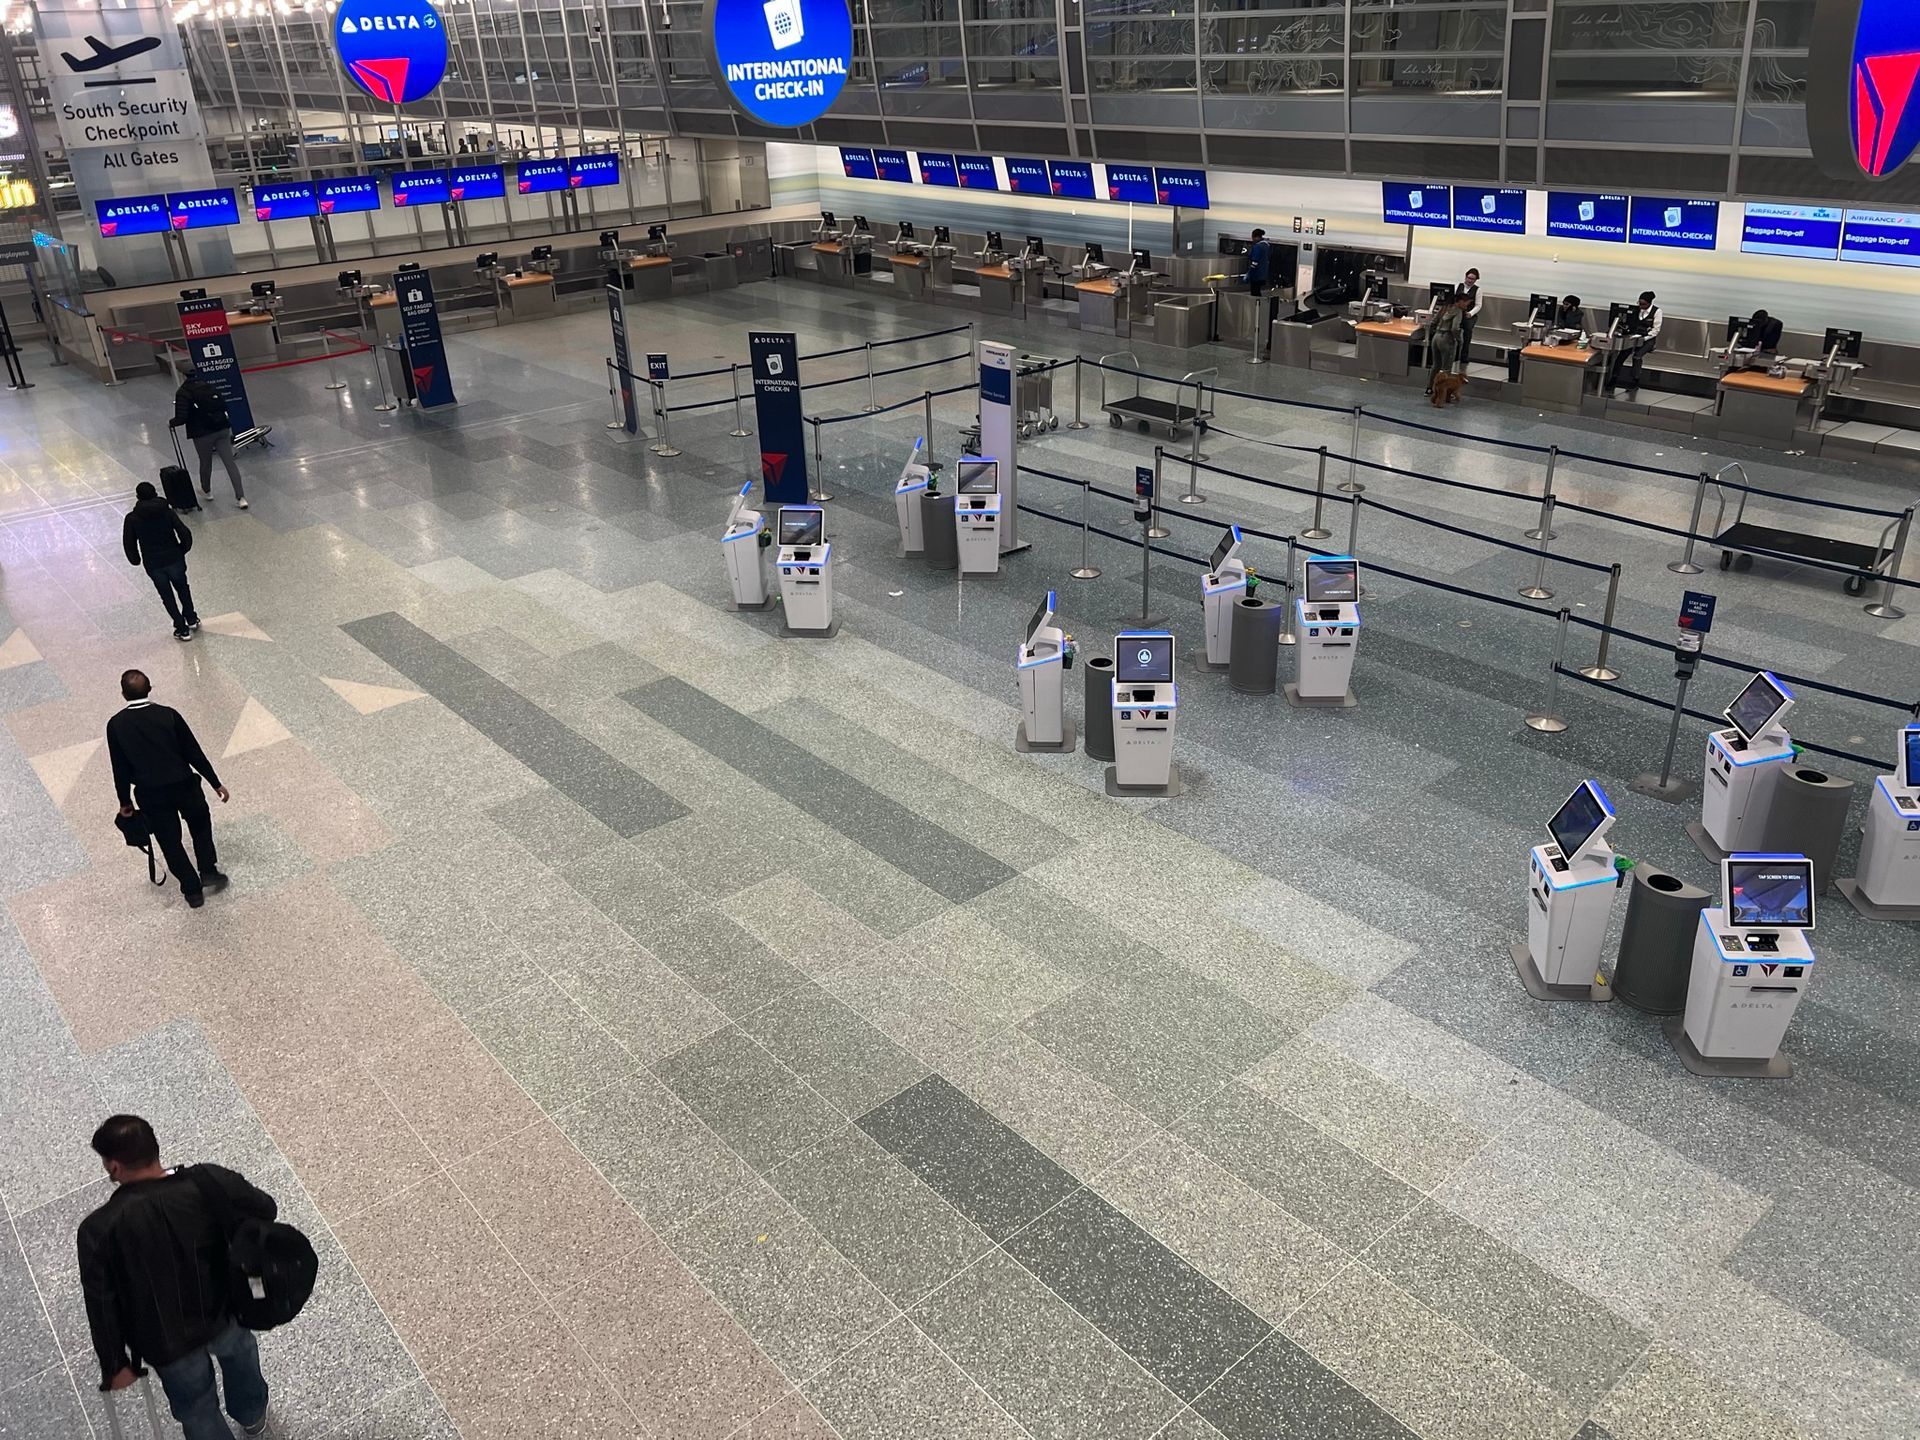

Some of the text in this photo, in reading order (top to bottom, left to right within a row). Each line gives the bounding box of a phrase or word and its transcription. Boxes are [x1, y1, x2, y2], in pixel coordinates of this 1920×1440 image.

[359, 15, 420, 30] DELTA
[727, 57, 847, 82] INTERNATIONAL
[754, 79, 824, 100] CHECK-IN
[64, 97, 188, 120] South Security
[84, 120, 180, 142] Checkpoint
[103, 149, 179, 169] All Gates
[928, 160, 946, 168] DELTA
[583, 162, 606, 170] DELTA
[1018, 167, 1037, 175] DELTA
[532, 167, 556, 176] DELTA
[1060, 170, 1082, 178] DELTA
[408, 178, 434, 187] DELTA
[465, 174, 490, 182] DELTA
[1119, 174, 1142, 182] DELTA
[1169, 178, 1194, 186] DELTA
[335, 184, 363, 194] DELTA
[272, 190, 301, 200] DELTA
[188, 198, 220, 209] DELTA
[117, 205, 150, 216] DELTA
[1386, 210, 1448, 220] INTERNATIONAL CHECK-IN
[1456, 215, 1522, 226] INTERNATIONAL CHECK-IN
[1550, 222, 1624, 234] INTERNATIONAL CHECK-IN
[1746, 226, 1804, 237] Baggage Drop-off
[1632, 228, 1712, 240] INTERNATIONAL CHECK-IN
[1846, 234, 1910, 246] Baggage Drop-off
[187, 325, 224, 336] PRIORITY
[196, 358, 234, 368] SELF-TAGGED
[650, 362, 666, 370] EXIT
